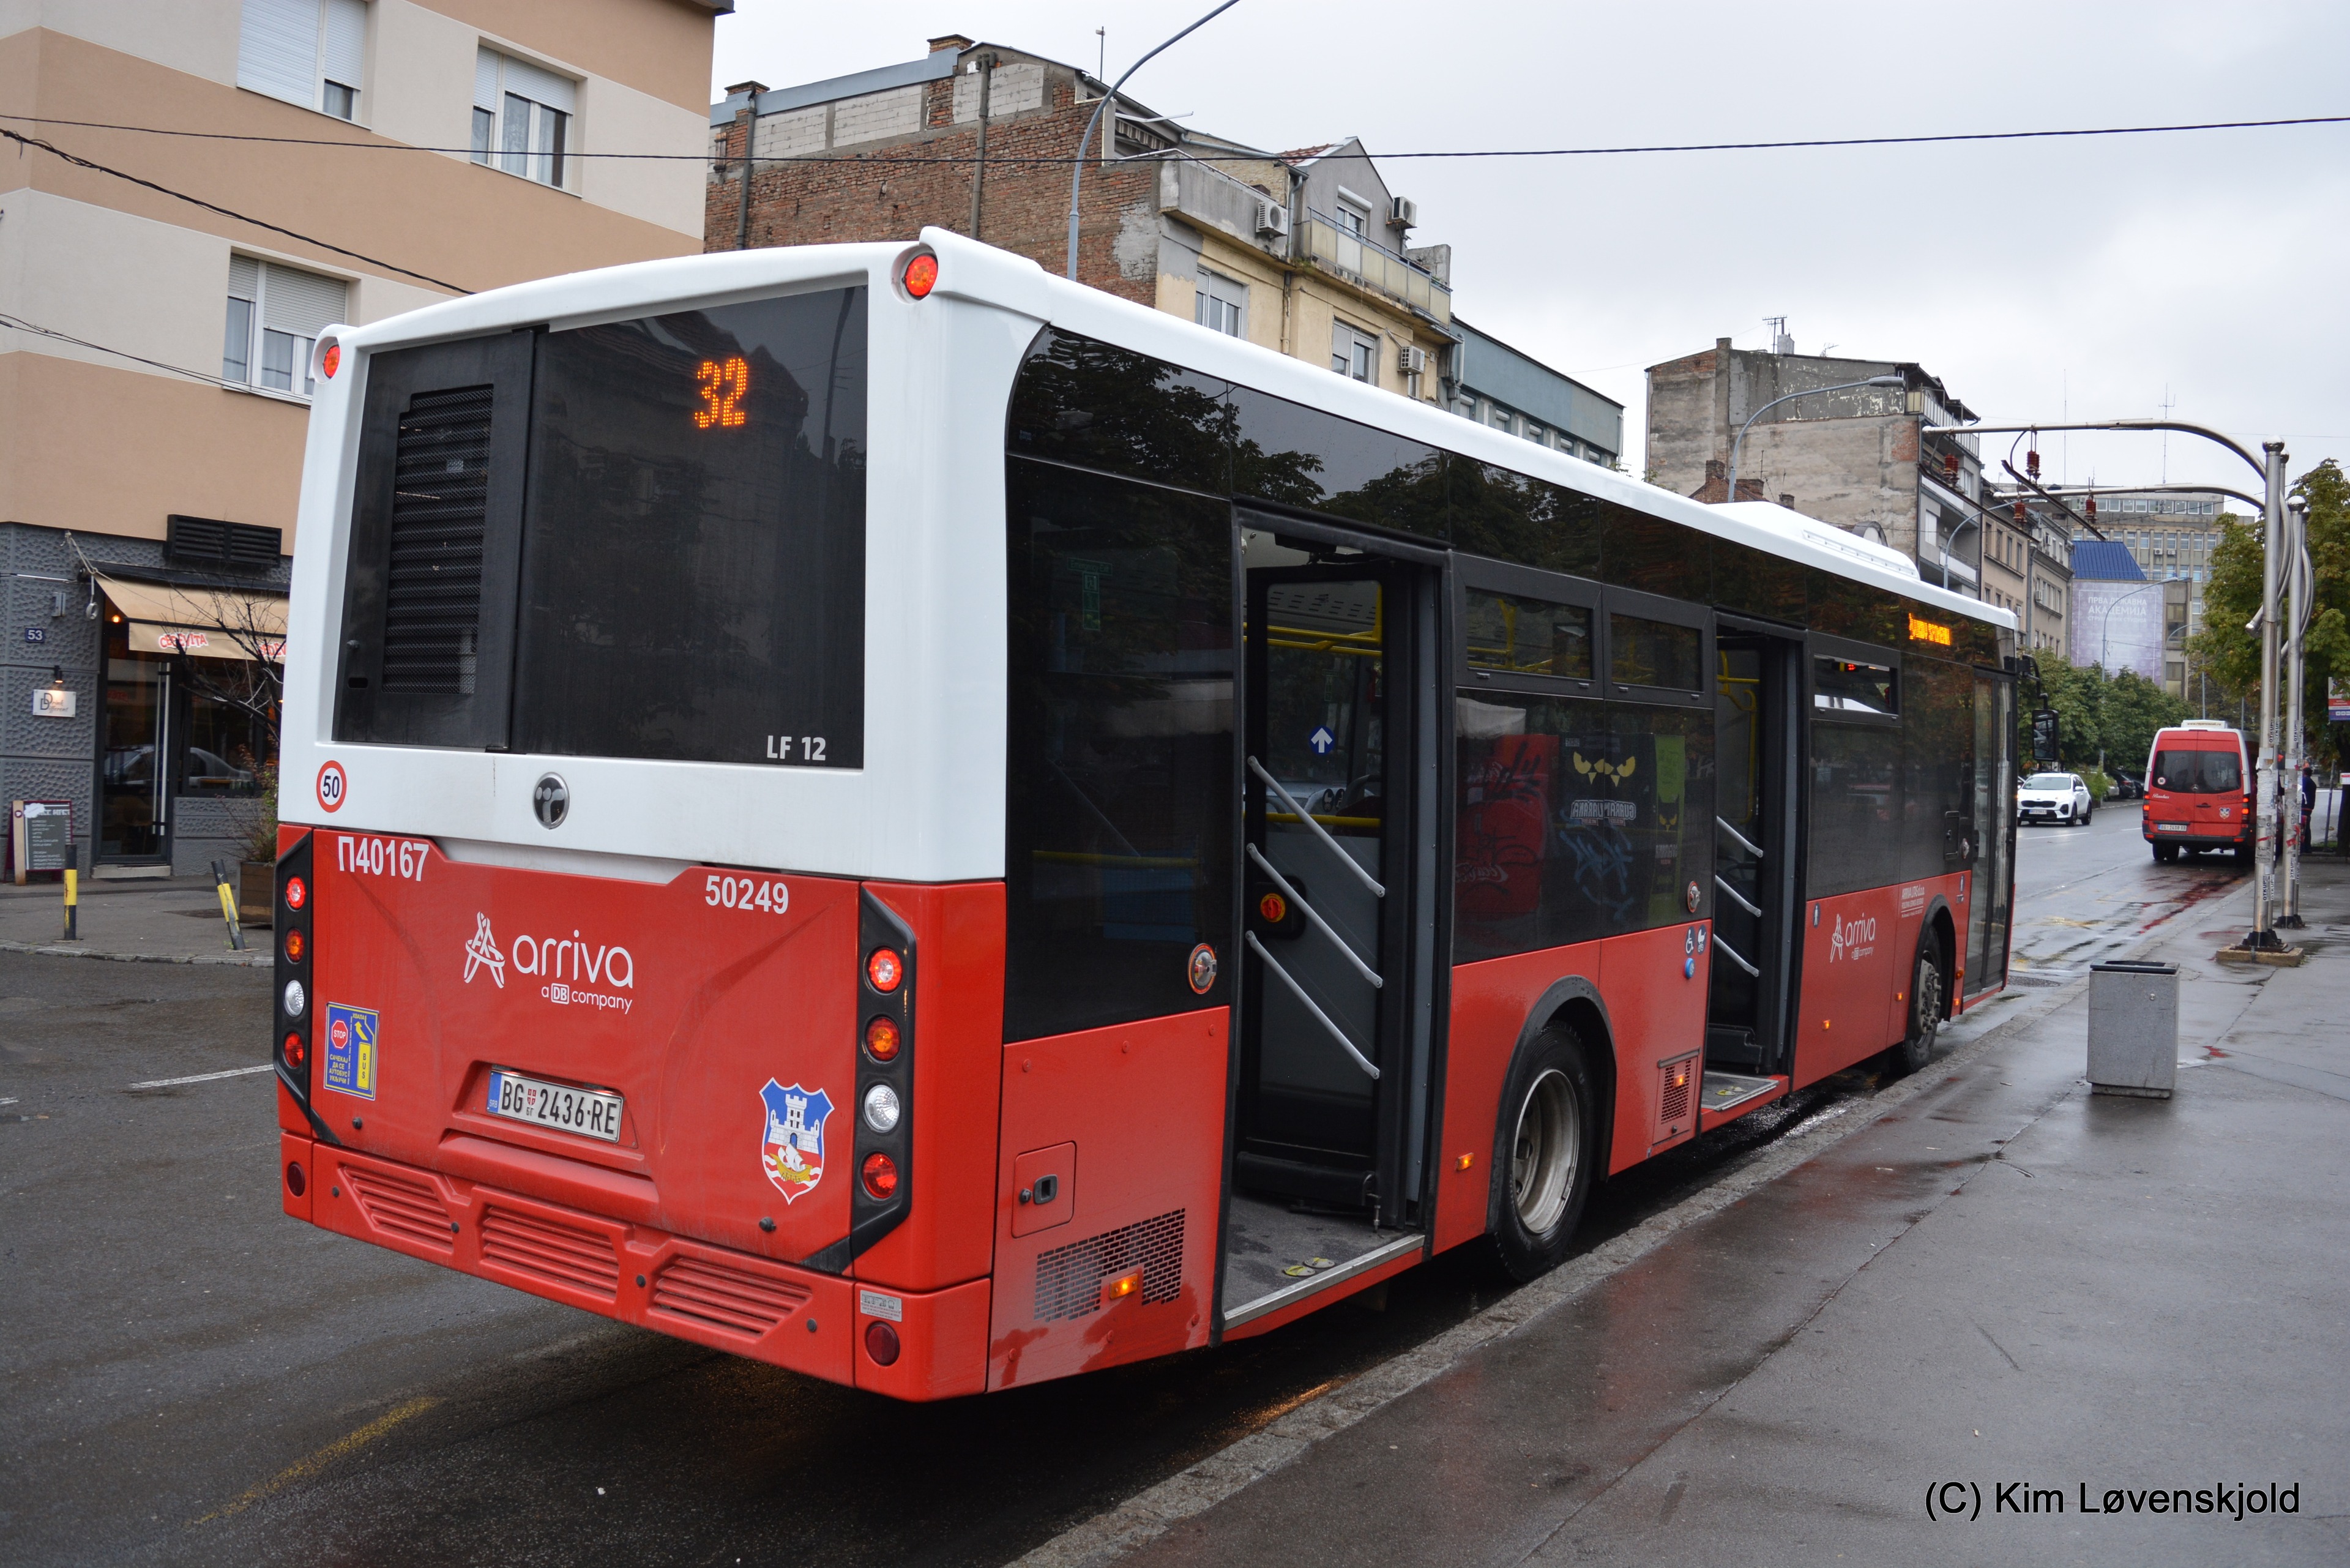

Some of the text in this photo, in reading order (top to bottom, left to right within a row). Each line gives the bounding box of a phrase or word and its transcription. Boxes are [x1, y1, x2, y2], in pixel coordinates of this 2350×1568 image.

[695, 358, 747, 427] 32
[2088, 605, 2147, 616] АКАДЕМИЈА
[28, 630, 43, 640] 53
[767, 735, 826, 761] LF 12
[323, 775, 340, 798] 50
[705, 875, 789, 914] 50249
[1845, 912, 1876, 947] arriva
[513, 929, 633, 988] arriva
[541, 985, 633, 1015] a DB company
[334, 1029, 346, 1039] STOP
[329, 1053, 348, 1064] САЧЕКАЈ
[329, 1068, 348, 1078] АУТОБУС
[489, 1099, 498, 1109] SRB
[501, 1080, 524, 1113] BG
